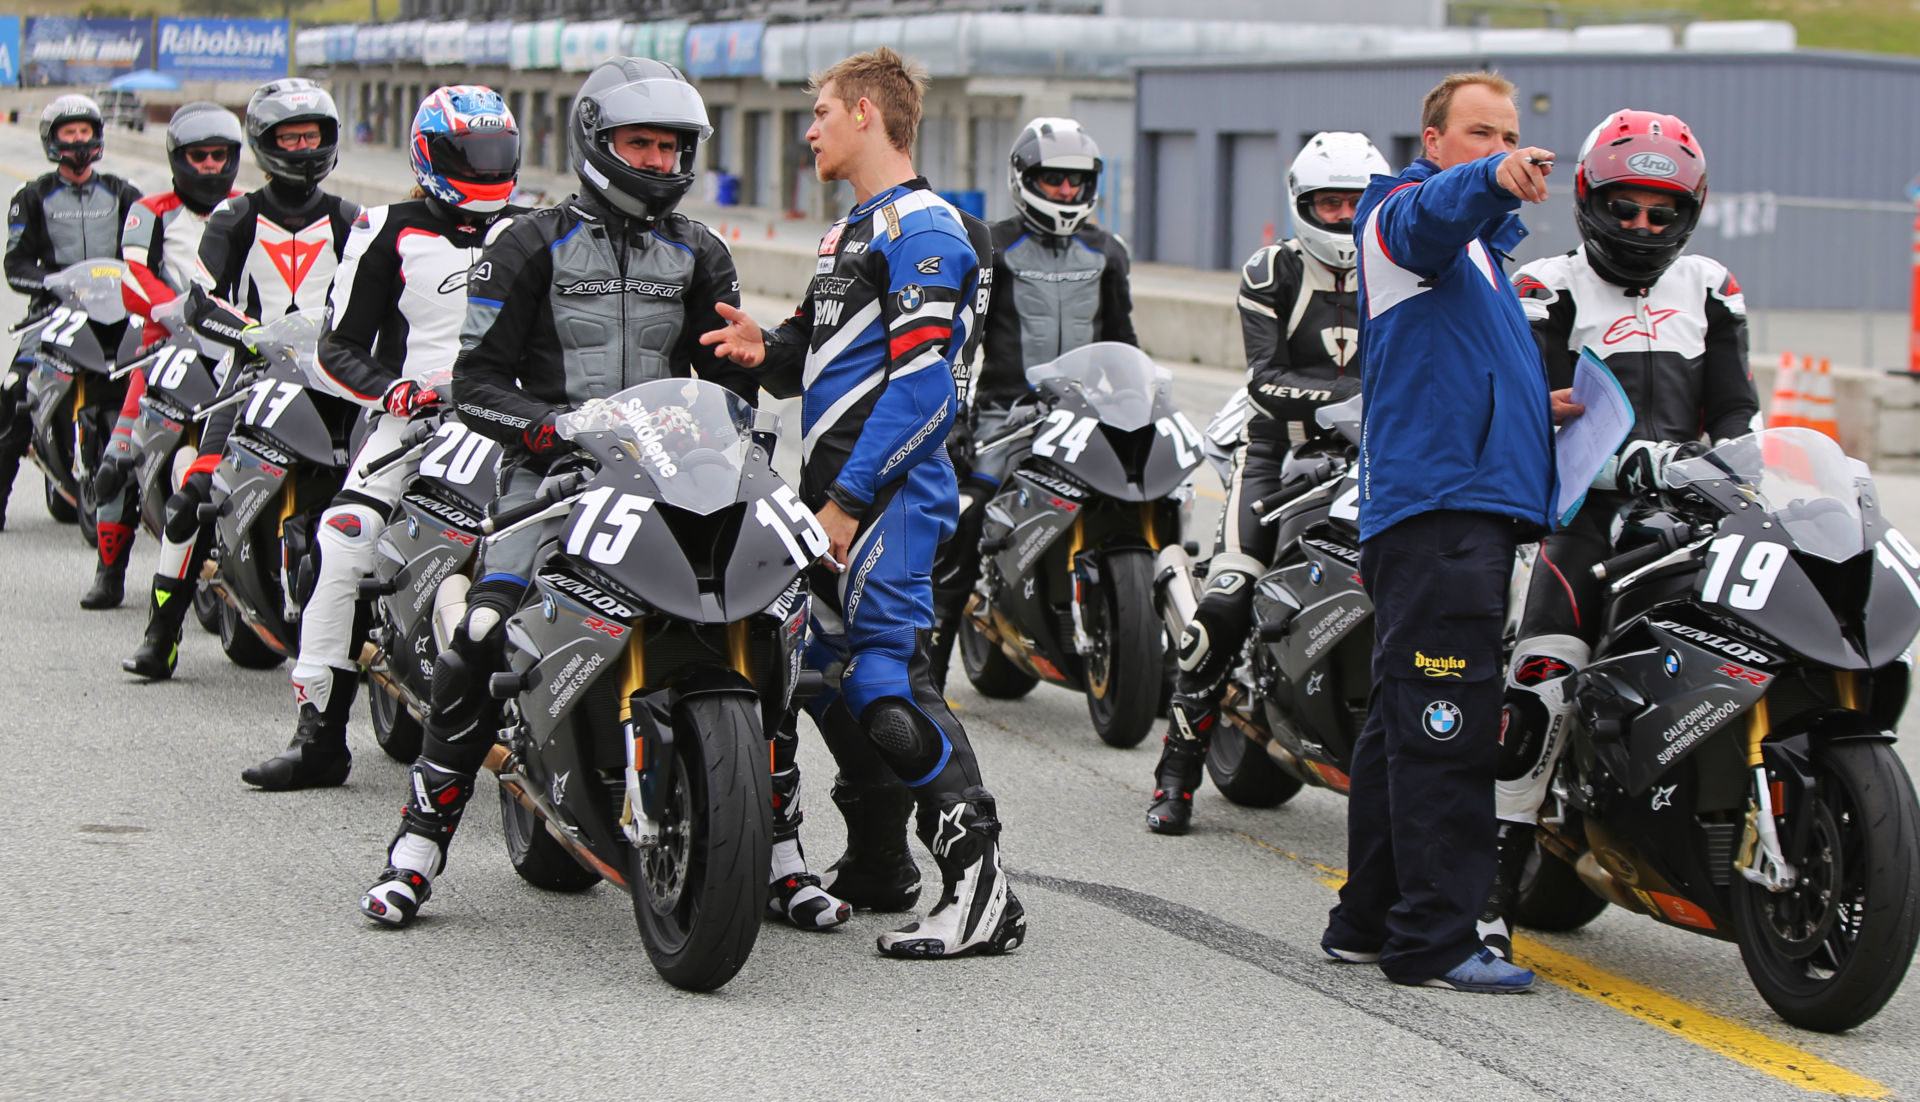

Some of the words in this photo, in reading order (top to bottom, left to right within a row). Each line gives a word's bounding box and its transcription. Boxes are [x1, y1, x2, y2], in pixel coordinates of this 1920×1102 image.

[160, 24, 287, 57] Rabobank
[1637, 156, 1672, 172] Arai
[560, 279, 684, 297] AGVSPORT
[41, 307, 88, 347] 22
[813, 300, 845, 326] BMW
[149, 345, 197, 389] 16
[244, 378, 303, 428] 17
[457, 404, 532, 429] AGVSPORT
[419, 422, 496, 485] 20
[622, 397, 678, 479] Silkolene
[877, 395, 951, 476] AGVSPORT
[1032, 409, 1099, 463] 24
[1155, 411, 1205, 469] 24
[258, 463, 284, 478] RR
[1016, 469, 1082, 498] DUNLOP
[405, 493, 478, 528] DUNLOP
[566, 486, 655, 565] 15
[755, 484, 831, 570] 15
[441, 528, 476, 547] RR
[413, 556, 441, 593] CALIFORNIA
[413, 579, 437, 612] SUPERBIKE
[434, 554, 458, 586] SCHOOL
[847, 531, 886, 624] AGVSPORT
[1702, 534, 1789, 611] 19
[542, 573, 633, 618] DUNLOP
[584, 616, 625, 639] RR
[1304, 626, 1339, 659] SUPERBIKE
[1335, 605, 1366, 633] SCHOOL
[1308, 605, 1346, 640] CALIFORNIA
[1651, 620, 1769, 664] DUNLOP
[548, 678, 580, 718] SUPERBIKE
[575, 652, 606, 686] SCHOOL
[549, 653, 585, 696] CALIFORNIA
[1414, 651, 1467, 677] drayko
[1719, 663, 1768, 687] RR
[1427, 702, 1459, 716] BMW
[1662, 700, 1716, 743] CALIFORNIA
[1656, 725, 1704, 765] SUPERBIKE
[1700, 700, 1742, 732] SCHOOL
